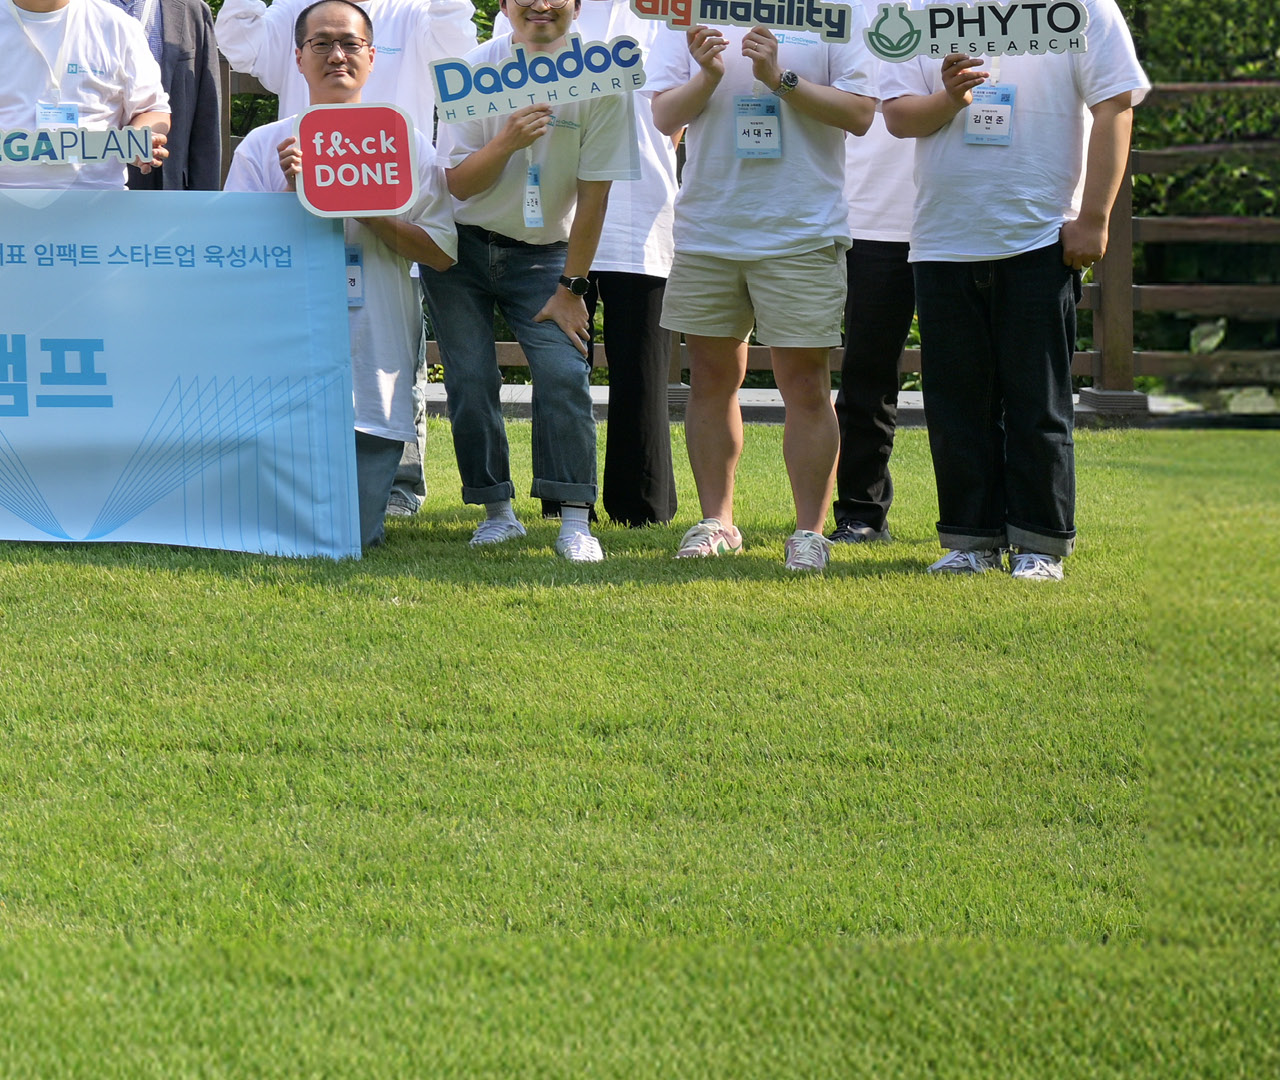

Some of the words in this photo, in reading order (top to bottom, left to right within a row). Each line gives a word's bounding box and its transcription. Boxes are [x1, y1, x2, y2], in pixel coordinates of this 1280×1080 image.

[930, 1, 1082, 38] PHYTO
[930, 38, 1080, 54] RESEARCH
[435, 38, 641, 102] Dadadoc
[445, 73, 643, 120] HEALTHCARE
[314, 163, 399, 187] DONE
[35, 241, 100, 267] 임팩트
[107, 242, 195, 268] 스타트업
[203, 242, 292, 269] 육성사업
